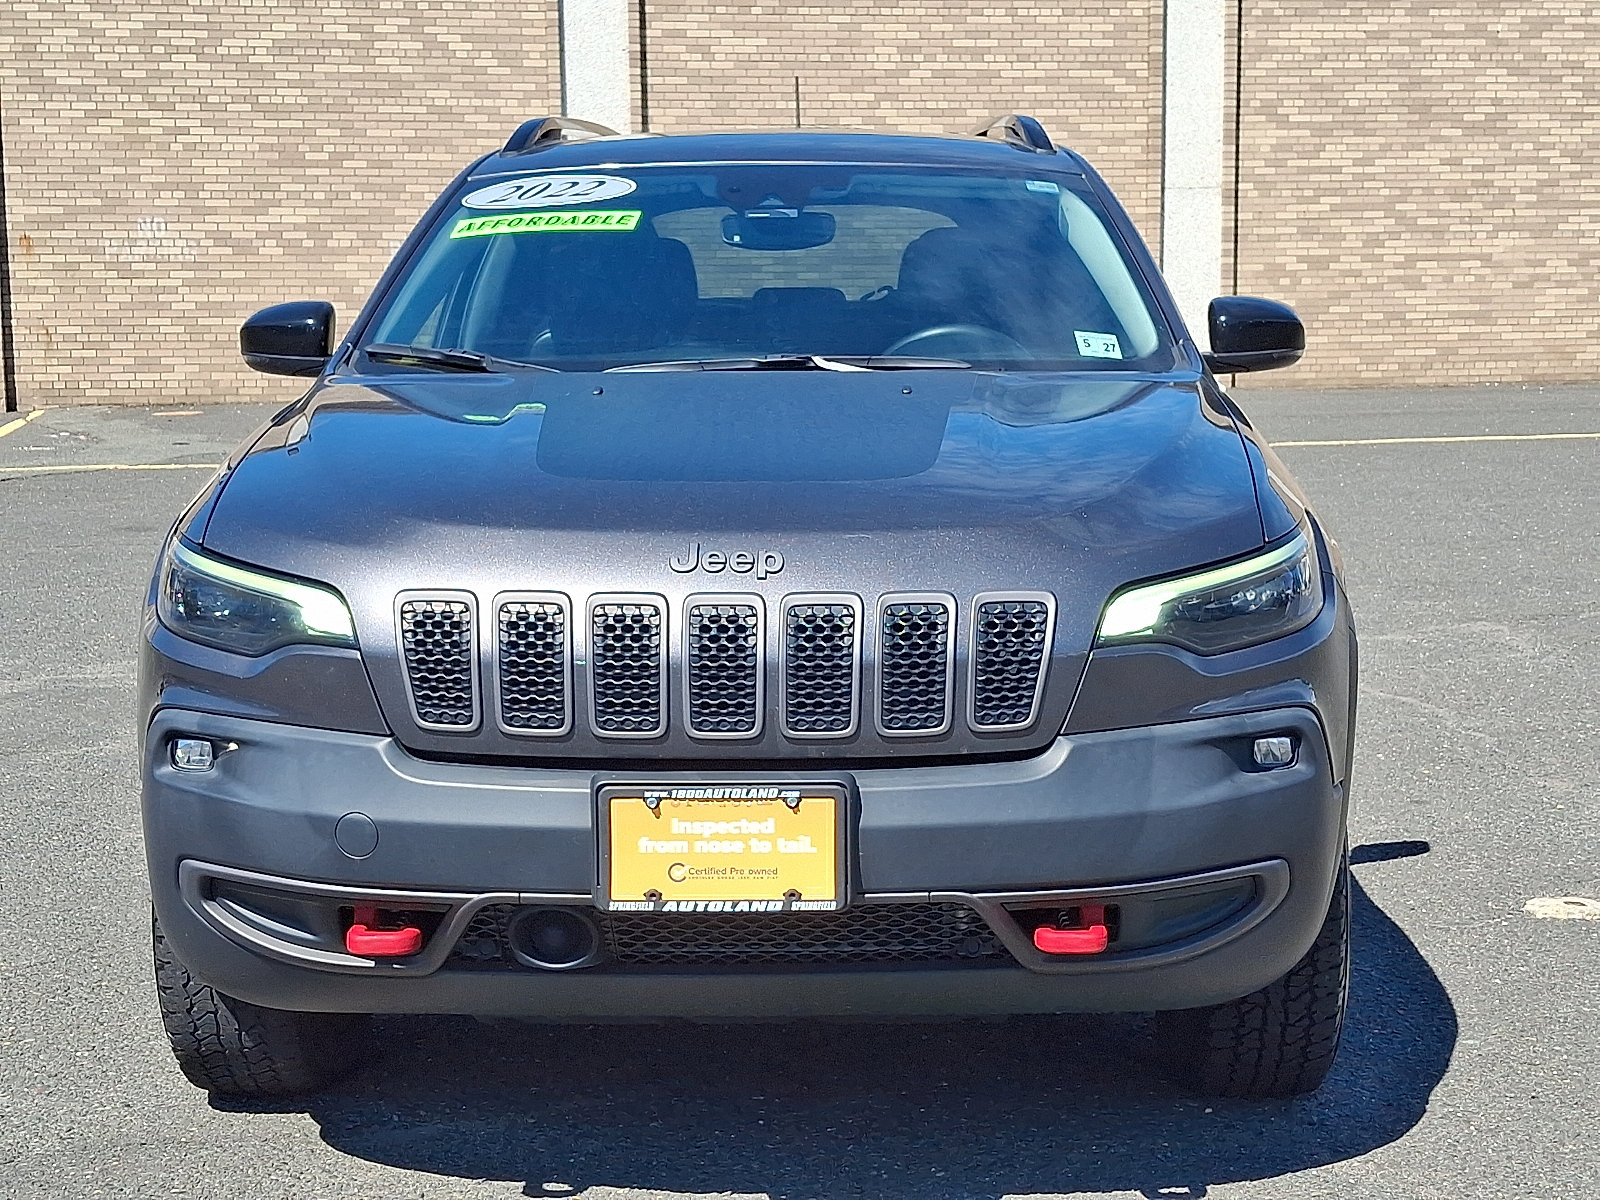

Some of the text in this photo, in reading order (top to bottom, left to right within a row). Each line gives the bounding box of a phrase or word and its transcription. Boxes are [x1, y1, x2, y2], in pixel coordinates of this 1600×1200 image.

[486, 181, 607, 204] 2022
[457, 214, 635, 233] AFFORDABLE
[1103, 343, 1115, 352] 27
[669, 542, 785, 580] Jeep
[637, 836, 689, 853] from
[694, 840, 747, 853] nose
[749, 837, 773, 853] to
[688, 867, 727, 875] Certified
[662, 901, 784, 912] AUTOLAND
